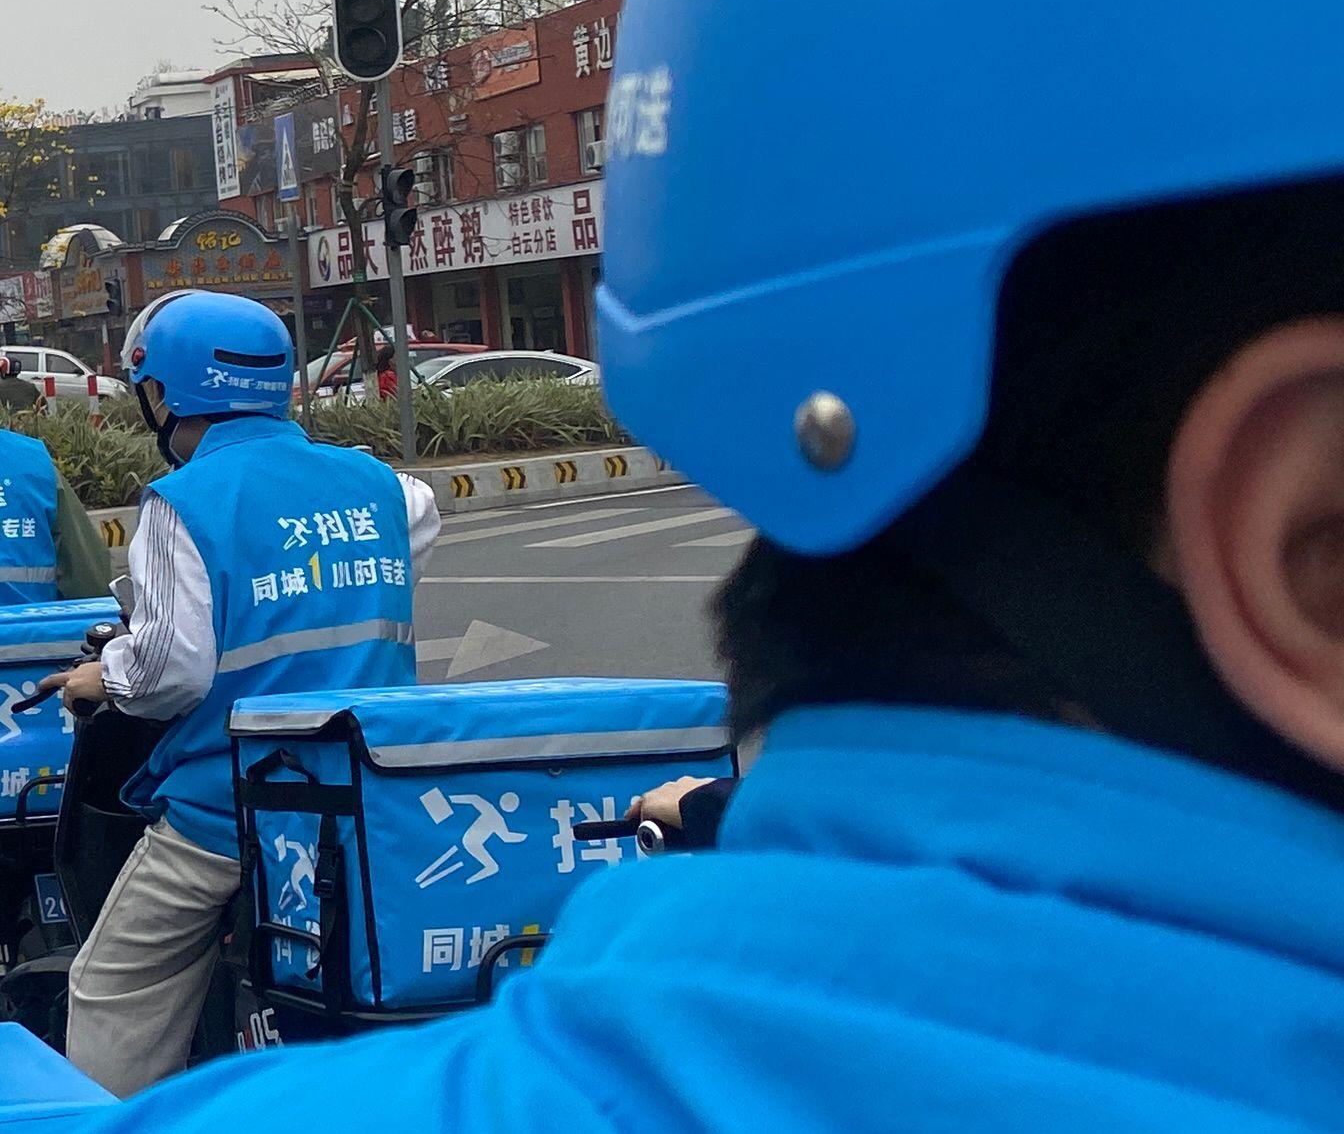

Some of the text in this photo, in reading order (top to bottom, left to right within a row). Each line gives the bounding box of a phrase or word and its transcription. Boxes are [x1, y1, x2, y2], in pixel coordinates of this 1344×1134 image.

[573, 15, 618, 78] 黄边
[509, 195, 554, 226] 特色餐饮
[572, 188, 600, 251] 品
[512, 226, 558, 256] 白云分店
[251, 551, 406, 607] 同城1小时专送
[423, 924, 555, 973] 同城1
